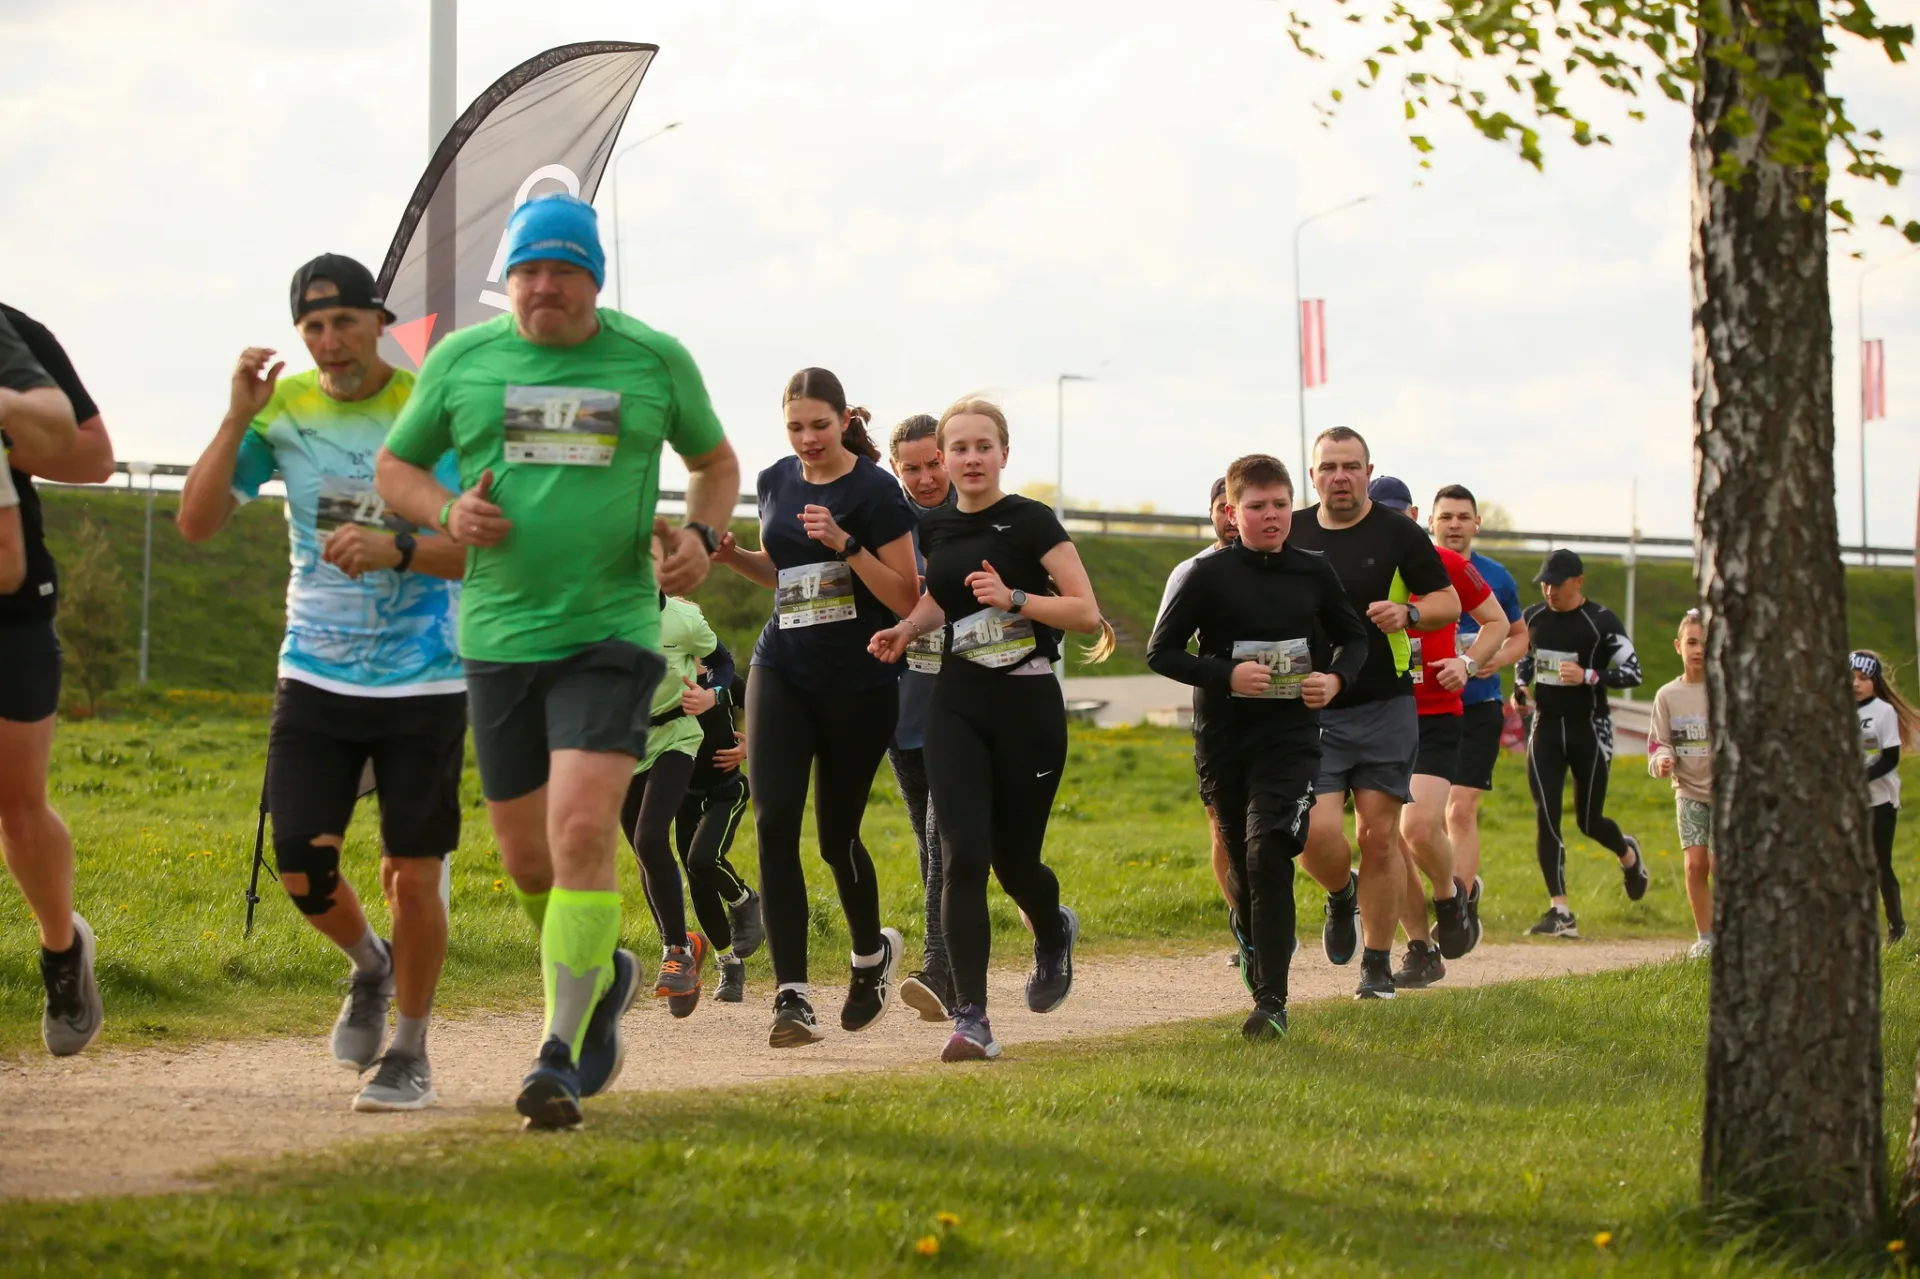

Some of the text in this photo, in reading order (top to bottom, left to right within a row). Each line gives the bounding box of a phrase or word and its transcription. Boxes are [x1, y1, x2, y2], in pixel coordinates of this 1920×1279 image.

[801, 572, 822, 599] 97
[975, 616, 1004, 645] 96
[1257, 650, 1292, 674] 125
